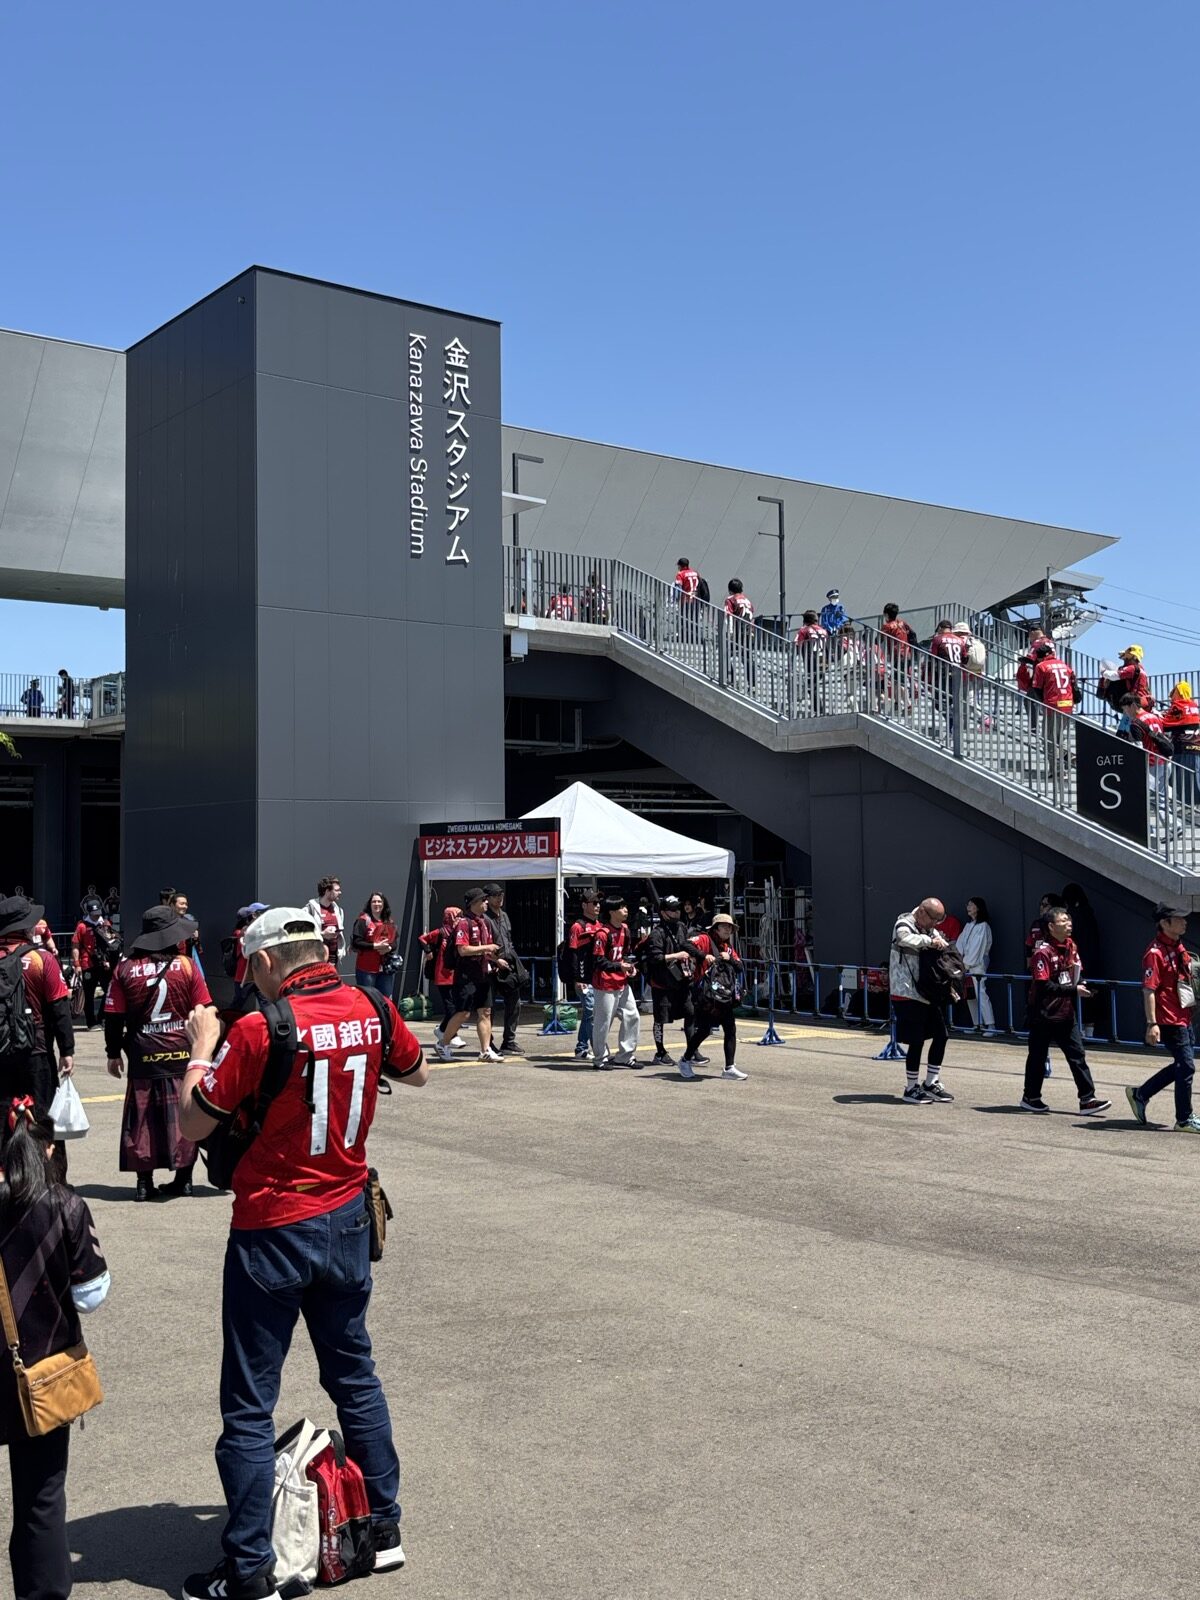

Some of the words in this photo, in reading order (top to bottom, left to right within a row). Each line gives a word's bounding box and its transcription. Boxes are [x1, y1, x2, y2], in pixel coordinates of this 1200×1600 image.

[409, 332, 427, 449] Kanazawa
[443, 337, 471, 563] 金沢スタジアム
[410, 457, 428, 554] Stadium
[945, 643, 961, 663] 18
[1052, 668, 1069, 688] 15
[1096, 754, 1124, 766] GATE
[1099, 772, 1122, 809] S
[447, 824, 468, 833] ZWEIGEN
[468, 823, 495, 832] KANAZAWA
[495, 822, 523, 831] HOMEGAME
[425, 835, 549, 856] ビジネスラウンジ入場口
[146, 977, 172, 1021] 2
[142, 1021, 184, 1033] NAGAMINE
[301, 1054, 367, 1156] 11
